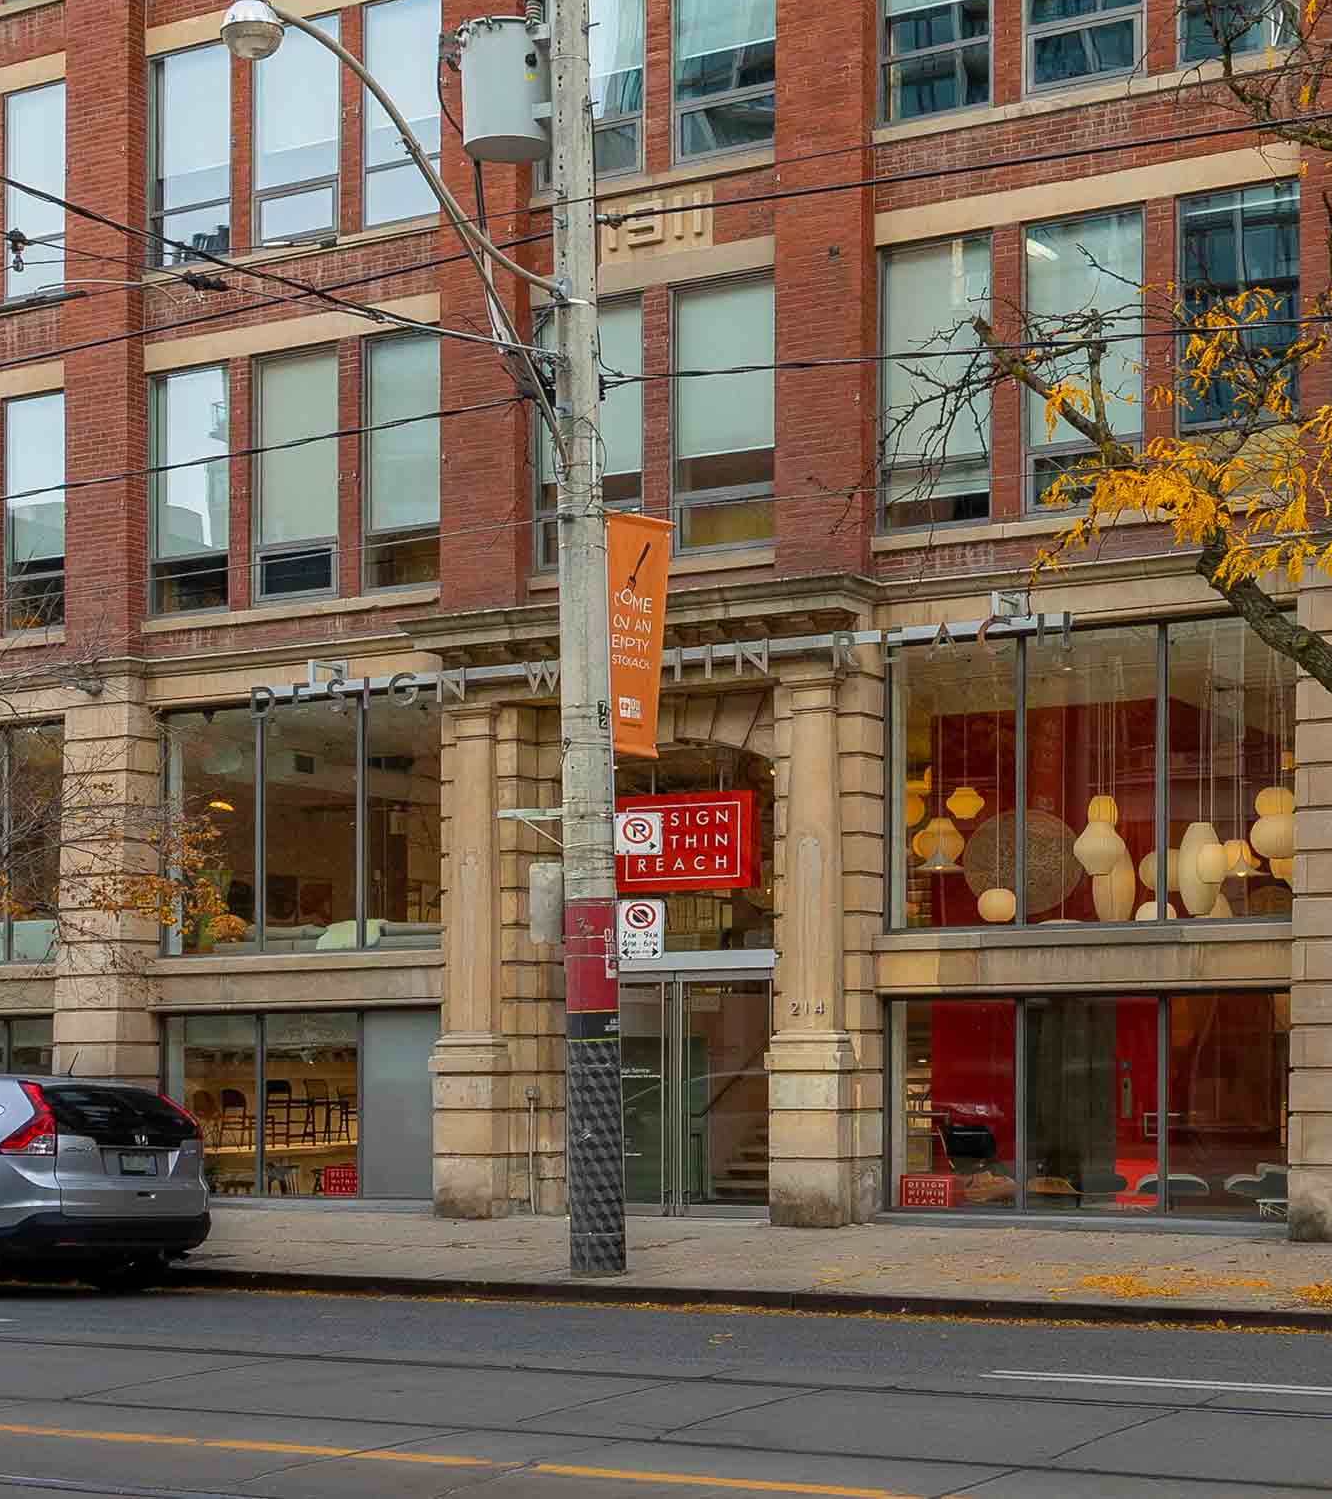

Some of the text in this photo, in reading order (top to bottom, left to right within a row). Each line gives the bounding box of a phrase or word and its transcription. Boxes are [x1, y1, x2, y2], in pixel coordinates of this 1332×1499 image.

[635, 618, 652, 634] AN
[660, 809, 729, 827] SIGN
[668, 833, 729, 850] THIN
[637, 855, 728, 872] REACH
[788, 998, 827, 1016] 214
